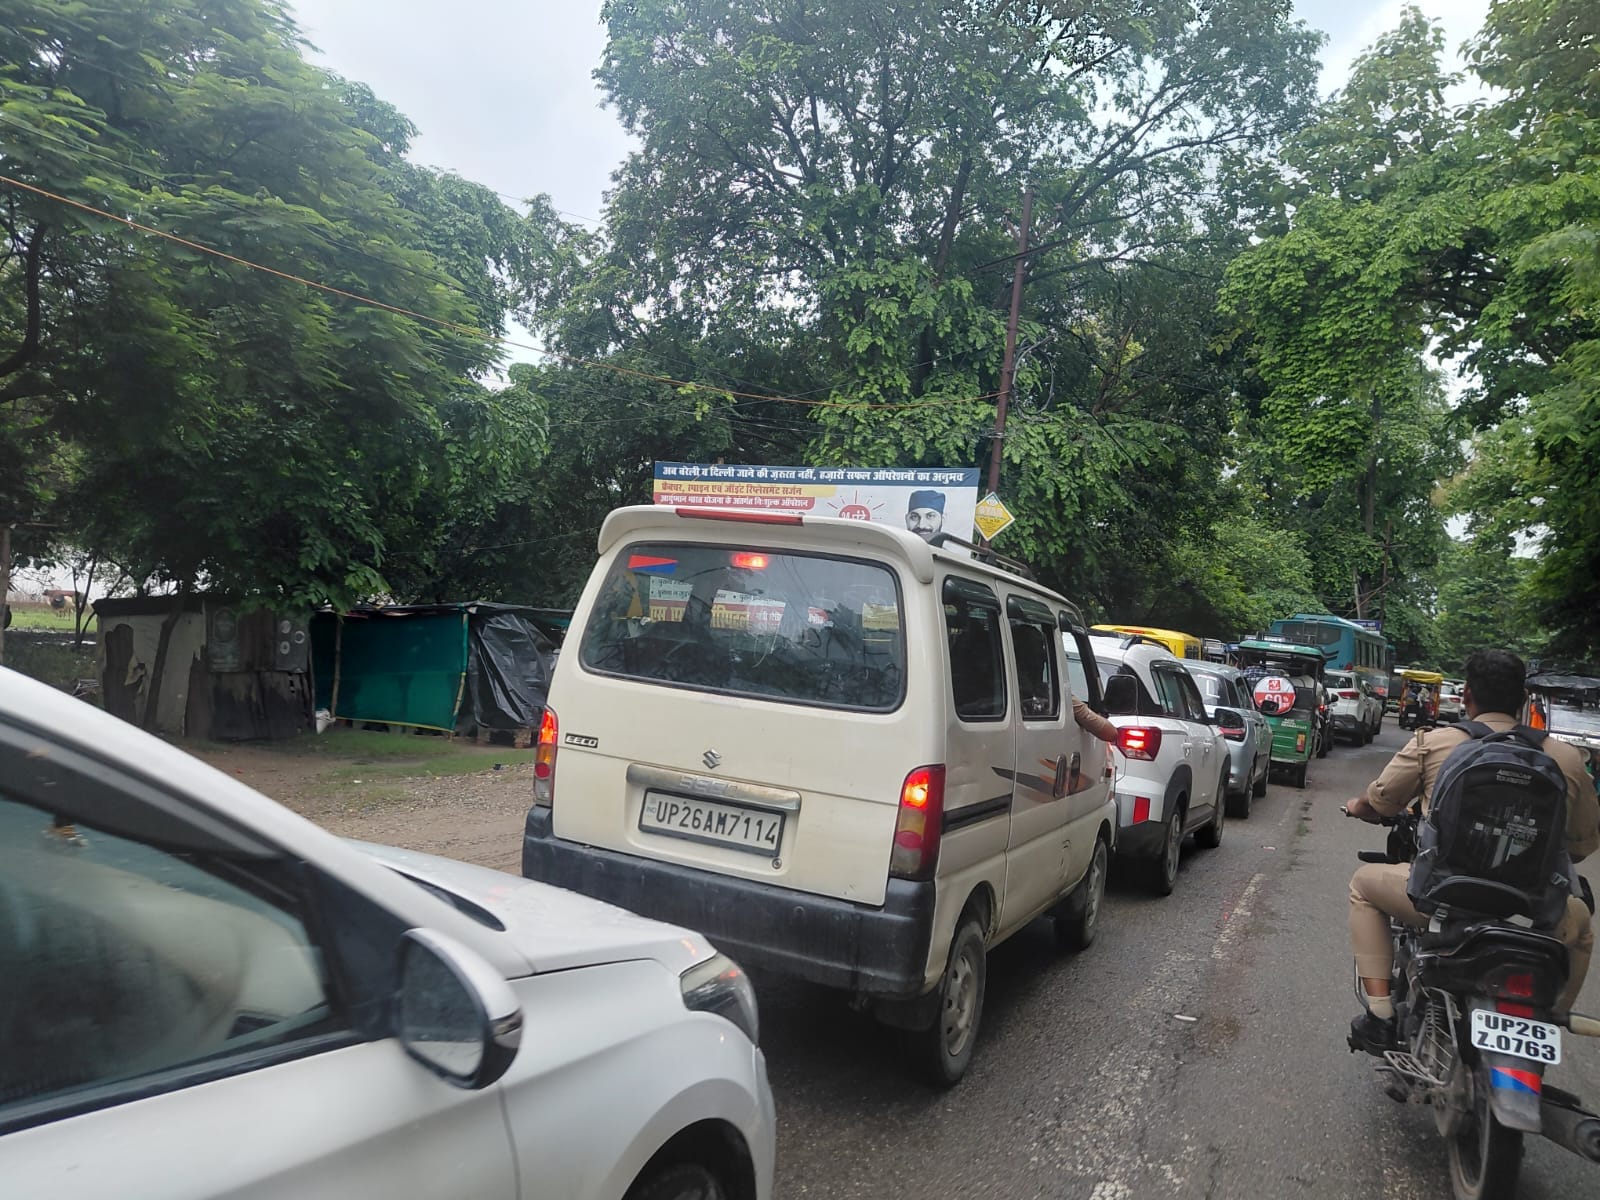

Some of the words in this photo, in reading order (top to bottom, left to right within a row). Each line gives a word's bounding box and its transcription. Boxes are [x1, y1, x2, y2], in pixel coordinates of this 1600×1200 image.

[663, 466, 677, 476] अब
[678, 465, 700, 476] बरेली
[701, 467, 708, 476] व
[709, 465, 735, 477] दिल्ली
[737, 467, 755, 478] जाने
[757, 467, 768, 478] की
[846, 471, 871, 480] सफल
[873, 469, 916, 481] ऑपरेशनों
[917, 472, 930, 481] का
[565, 735, 598, 747] EECO
[656, 801, 778, 845] UP26AM7114
[1483, 1014, 1547, 1040] UP26
